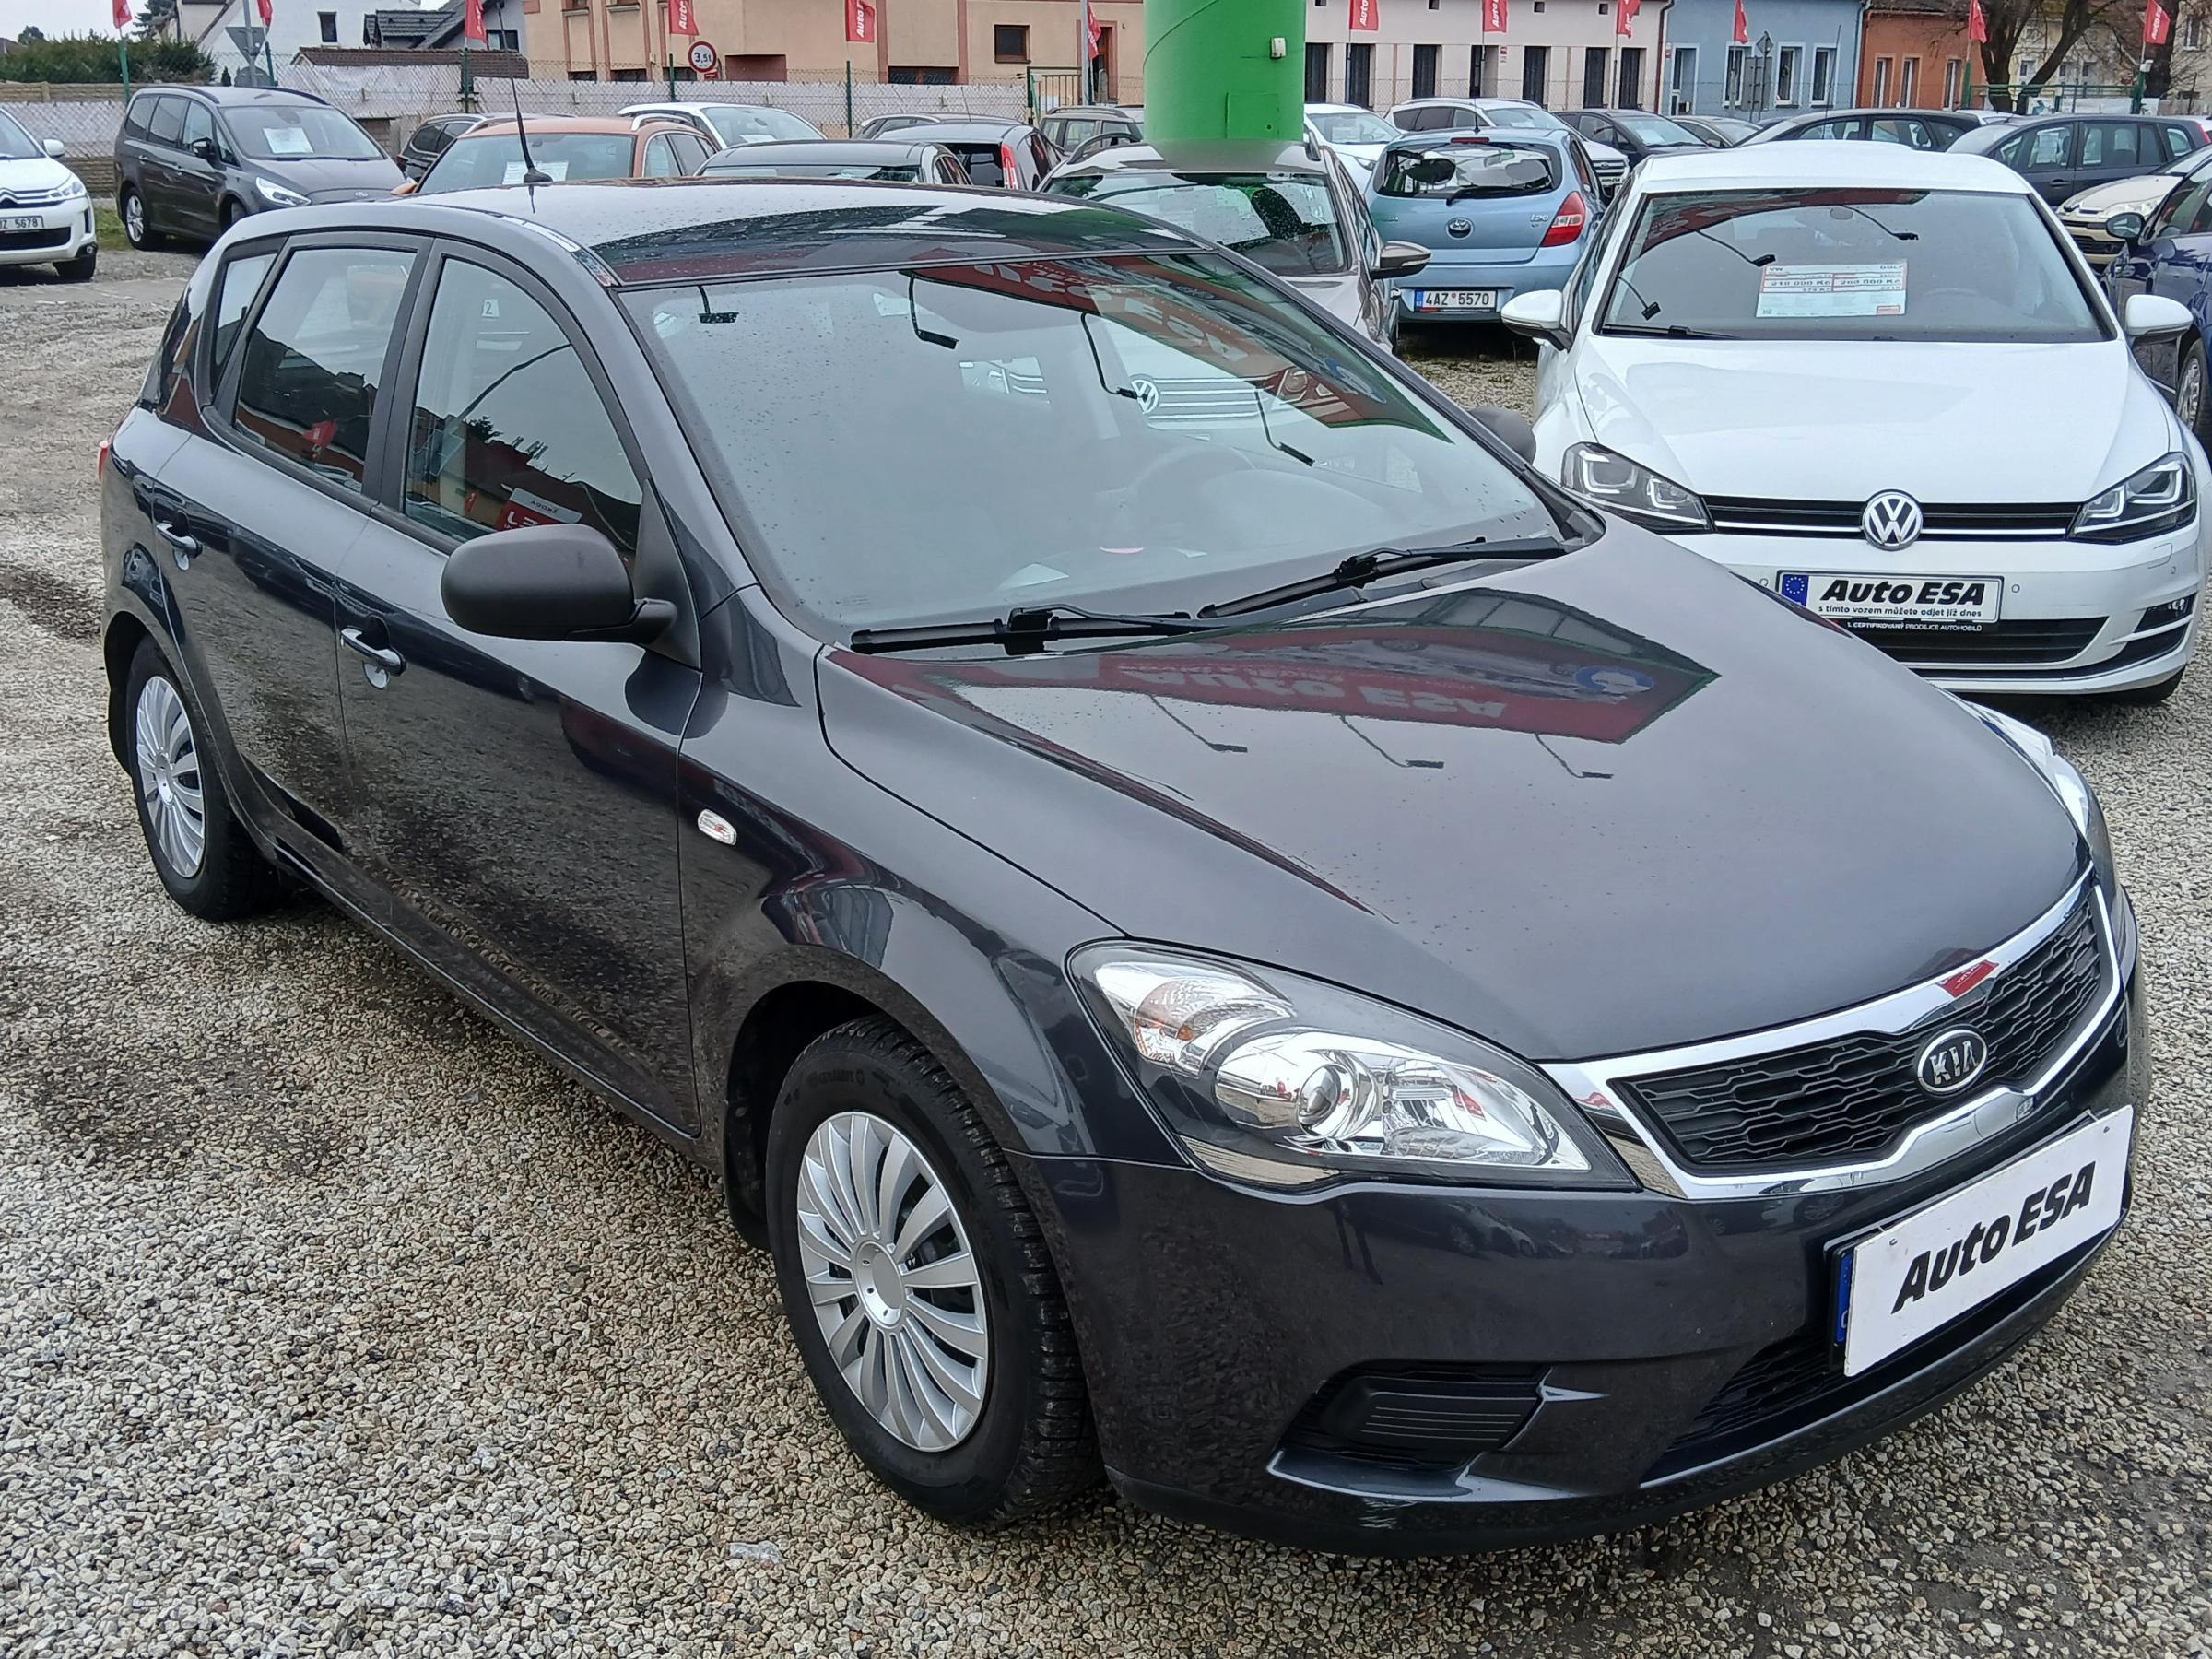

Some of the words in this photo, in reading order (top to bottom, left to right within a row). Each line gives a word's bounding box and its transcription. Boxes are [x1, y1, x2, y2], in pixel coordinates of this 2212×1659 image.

[1426, 292, 1449, 306] 4AZ
[1458, 291, 1489, 306] 5570
[1819, 579, 1916, 603] Auto
[1915, 582, 1986, 606] ESA
[1853, 606, 1882, 615] vozem
[1921, 606, 1945, 617] odjet
[1960, 609, 1982, 618] dnes
[1929, 1040, 1979, 1085] KIA
[1891, 1214, 2011, 1315] Auto
[2012, 1160, 2097, 1248] ESA
